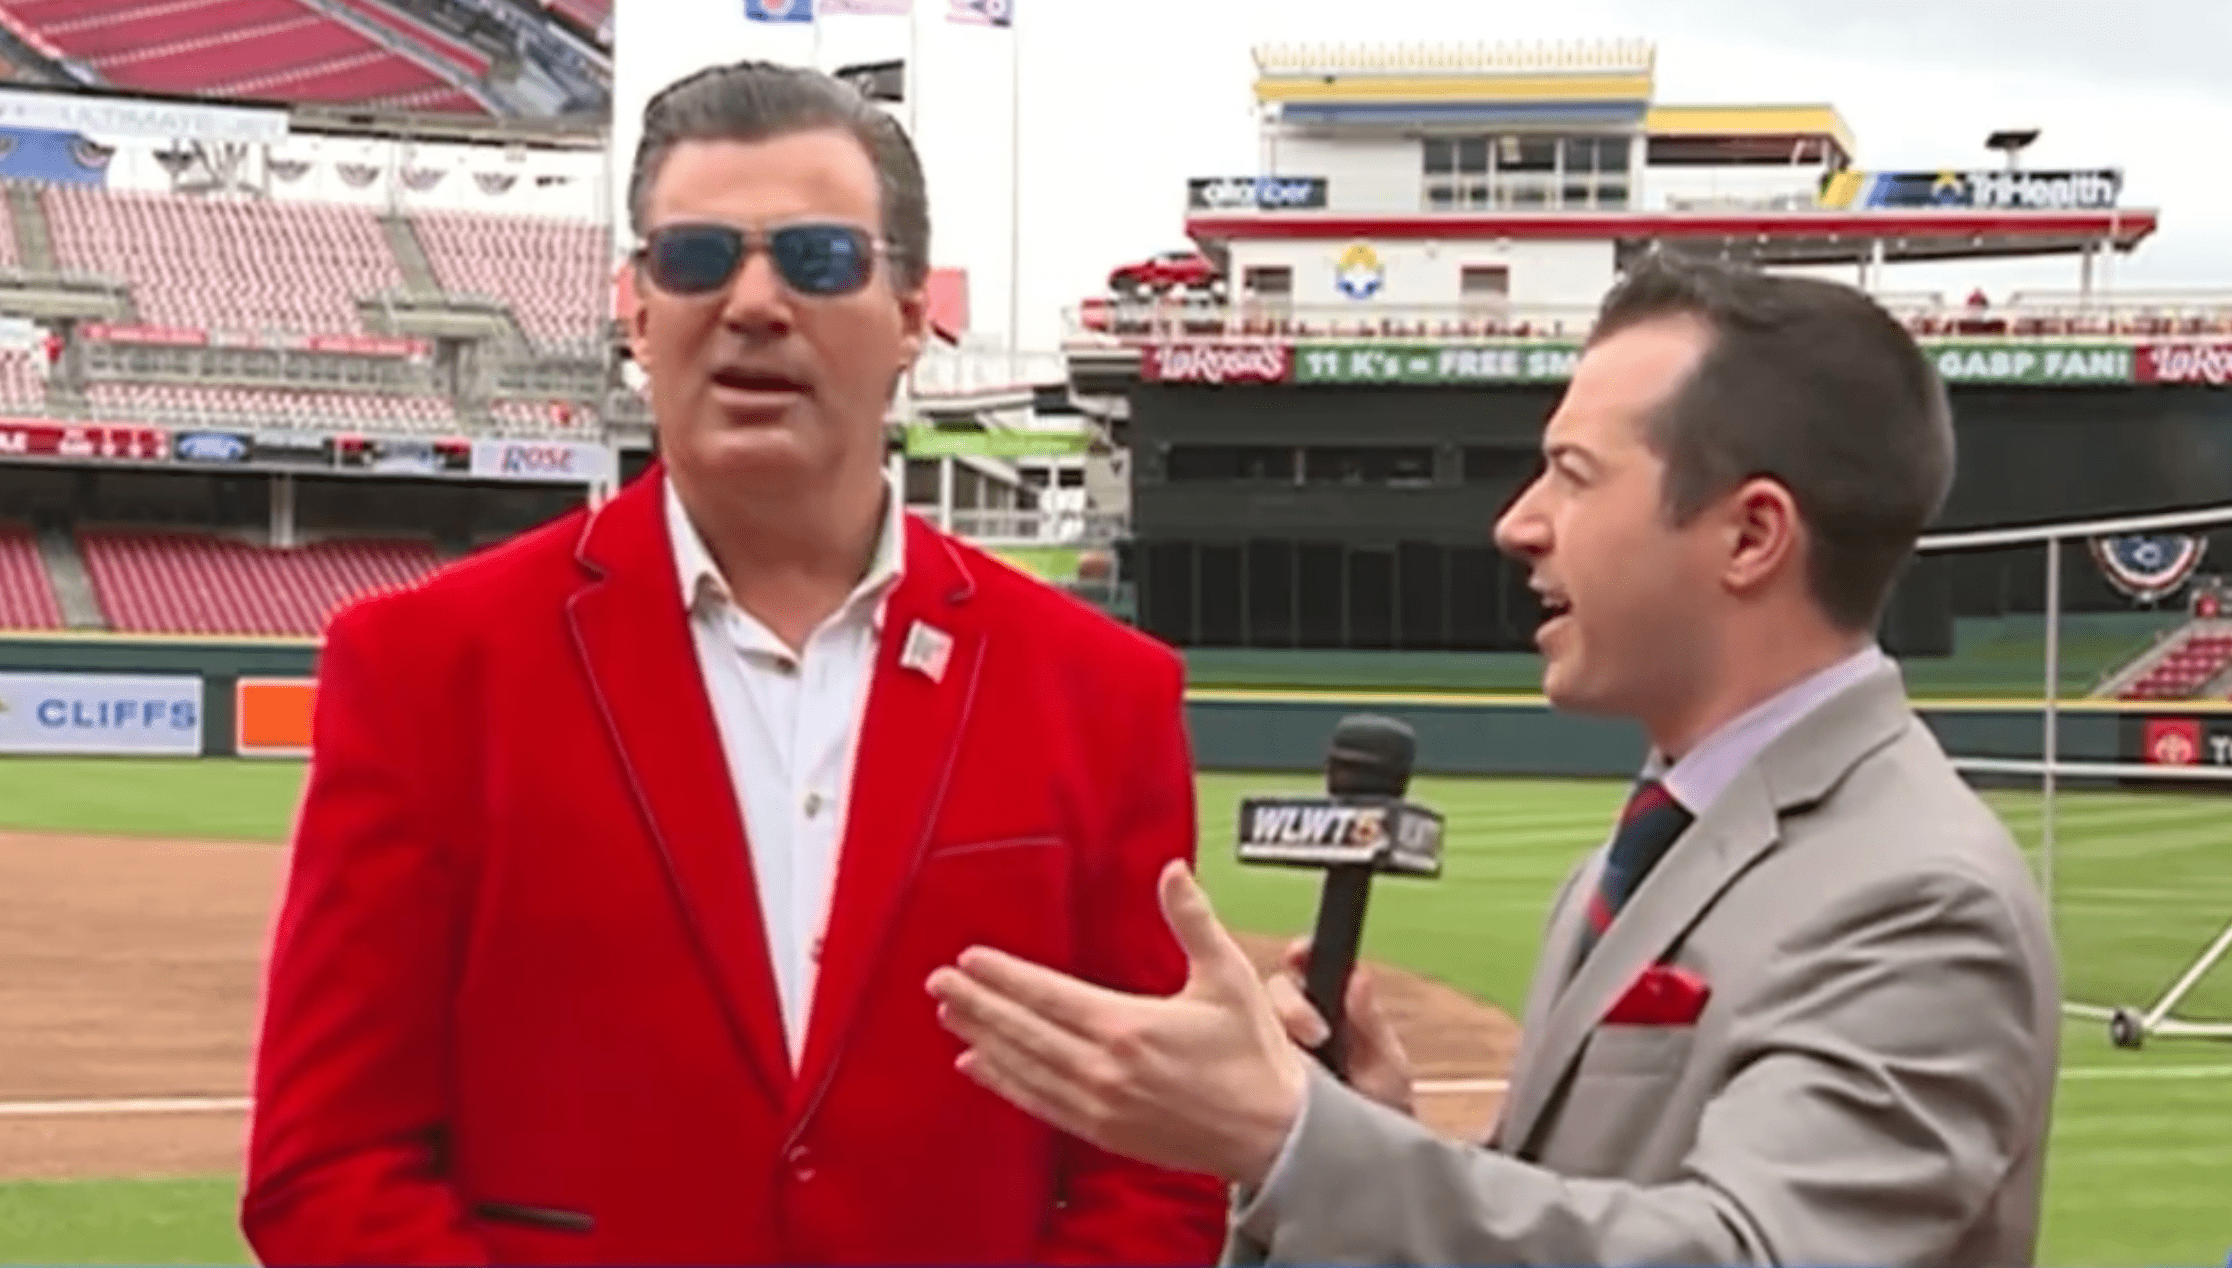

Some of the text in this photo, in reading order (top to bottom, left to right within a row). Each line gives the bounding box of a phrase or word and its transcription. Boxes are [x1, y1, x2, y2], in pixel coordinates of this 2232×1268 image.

[1967, 170, 2115, 207] TriHealth
[1439, 350, 1521, 376] FREE
[1938, 351, 2128, 377] GABP FAN!
[36, 698, 197, 730] CLIFFS
